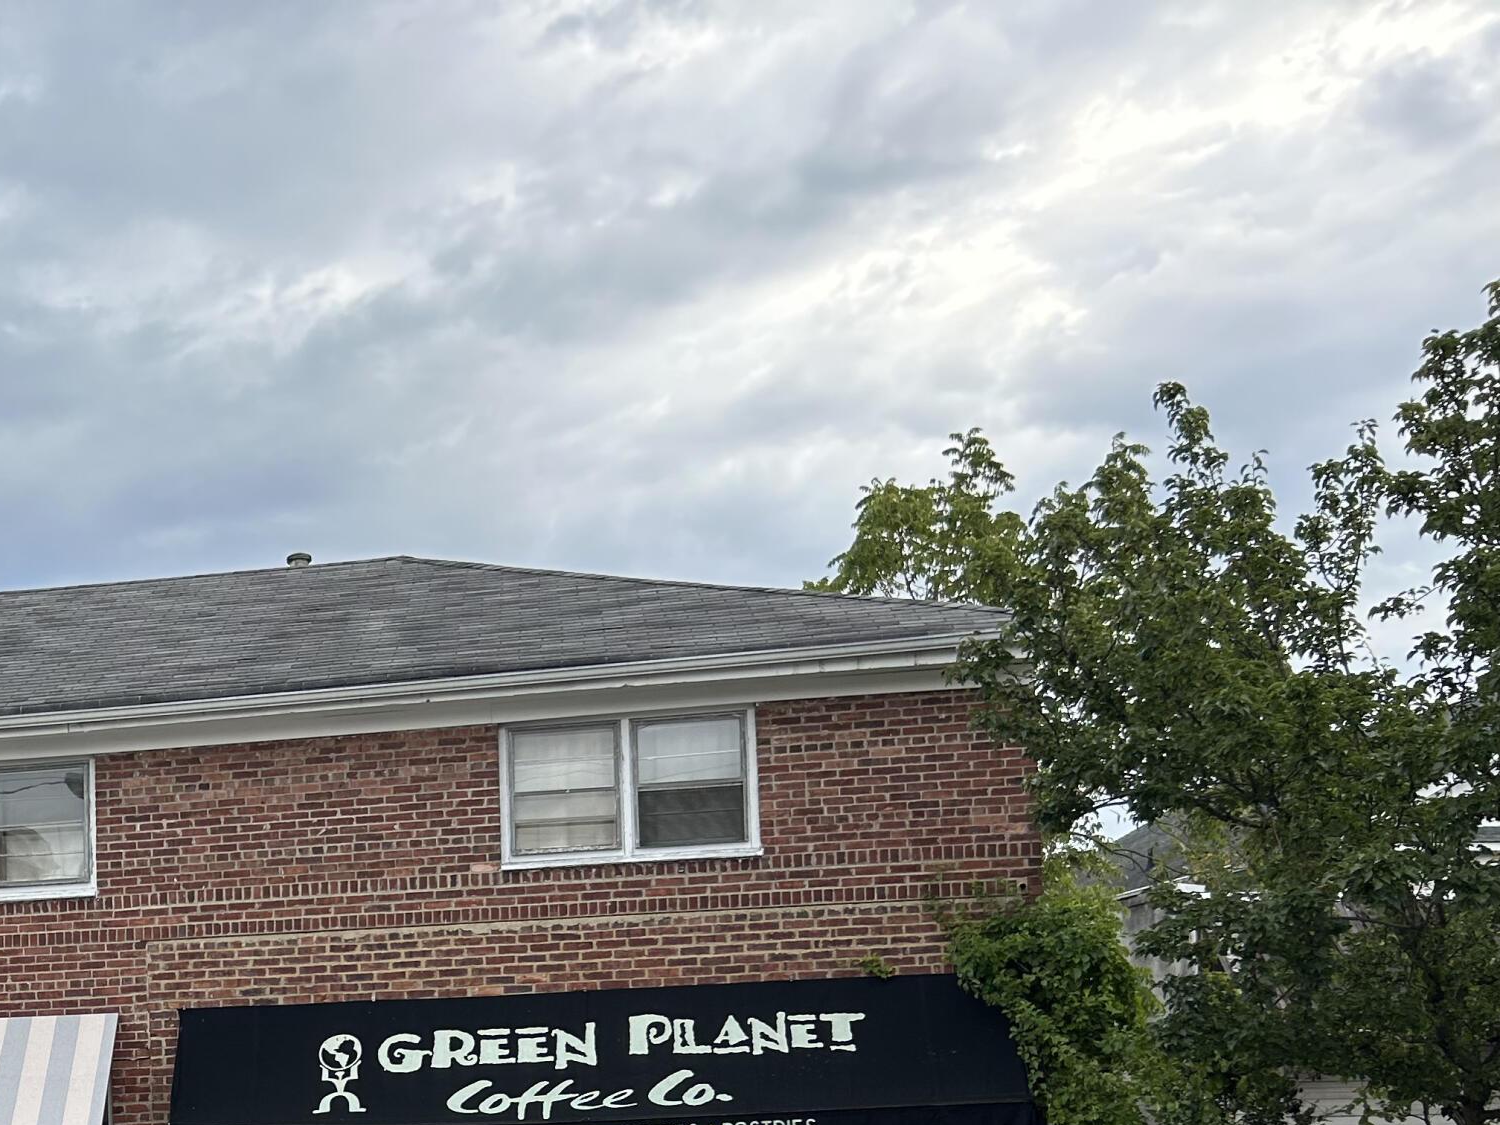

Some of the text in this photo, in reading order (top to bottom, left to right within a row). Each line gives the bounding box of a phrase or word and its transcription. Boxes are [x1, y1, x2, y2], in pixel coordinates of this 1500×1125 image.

[377, 1011, 866, 1073] GREEN PLANET
[446, 1069, 734, 1121] Coffee Co.
